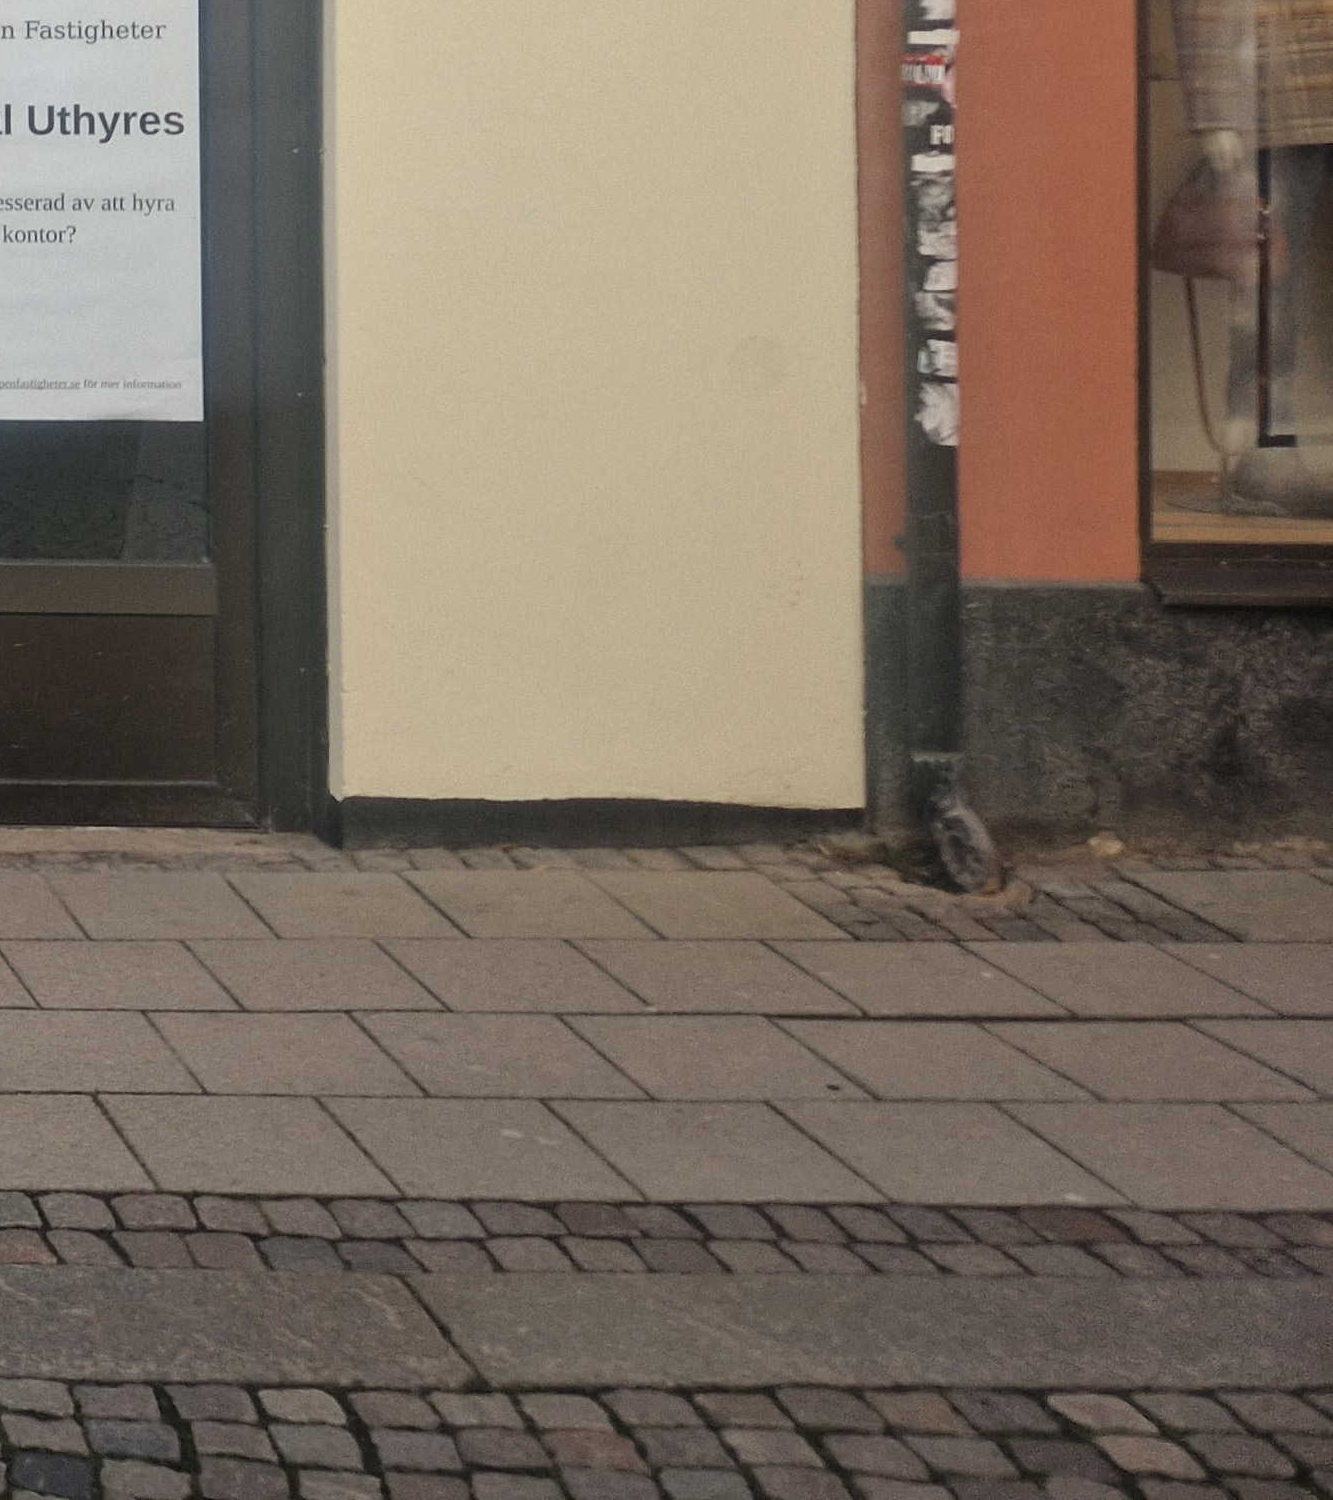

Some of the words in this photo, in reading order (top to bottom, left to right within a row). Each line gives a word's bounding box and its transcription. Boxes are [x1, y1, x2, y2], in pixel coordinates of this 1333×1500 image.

[24, 19, 167, 45] Fastigheter
[27, 103, 185, 145] Uthyres
[71, 197, 96, 212] av
[101, 195, 126, 212] att
[132, 192, 176, 217] hyra
[2, 224, 77, 243] kontor?
[84, 379, 99, 389] för
[101, 381, 121, 390] mer
[123, 379, 182, 390] information
